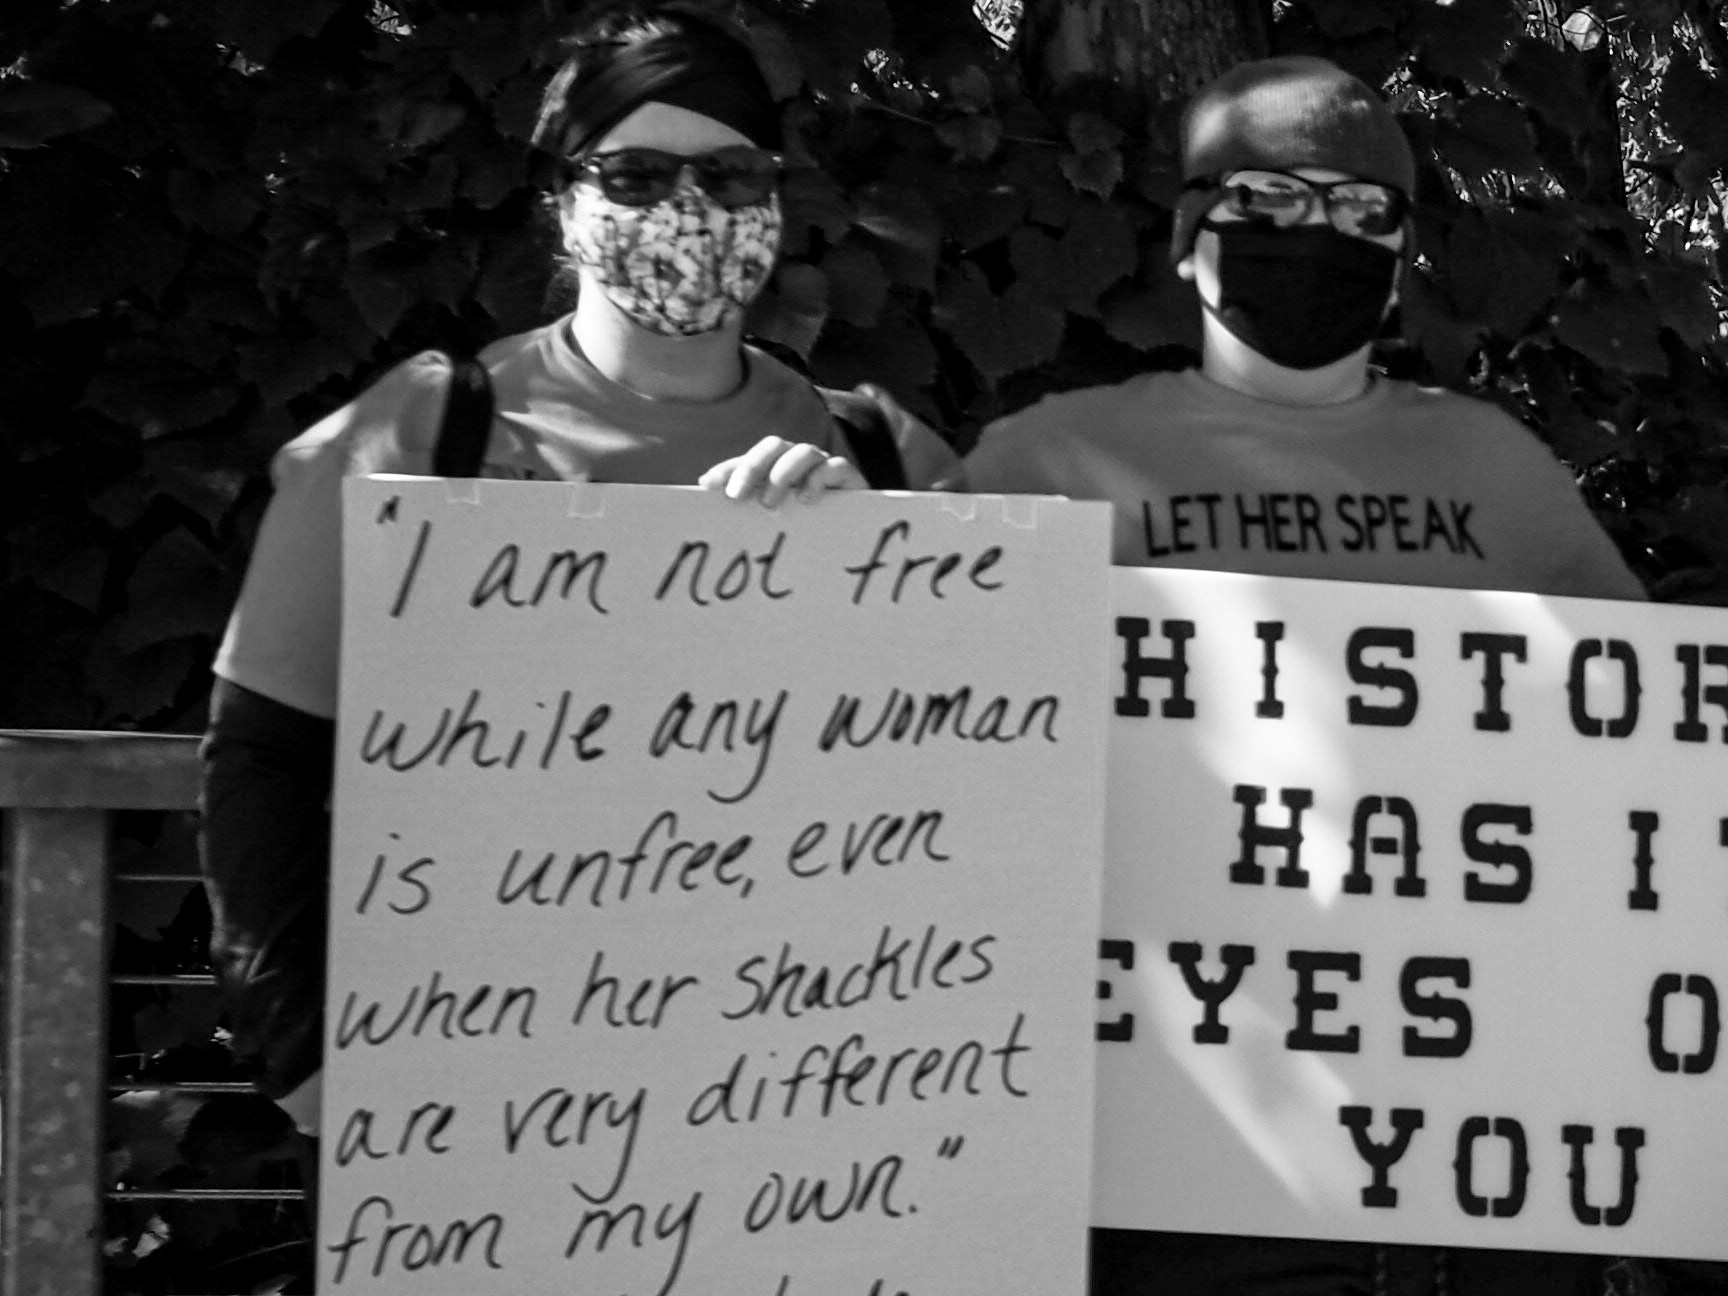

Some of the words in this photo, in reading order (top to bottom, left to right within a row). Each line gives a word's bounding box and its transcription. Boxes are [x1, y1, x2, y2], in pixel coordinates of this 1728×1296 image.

[470, 540, 608, 612] am
[655, 532, 793, 606] not
[846, 524, 1004, 604] free
[1142, 494, 1222, 558] LET
[1234, 493, 1328, 554] HER
[1335, 493, 1486, 561] SPEAK
[362, 690, 606, 771] while
[650, 689, 789, 802] any
[819, 688, 1059, 751] woman
[358, 833, 433, 914] is
[497, 812, 756, 907] unfree,
[789, 807, 950, 878] even
[1229, 784, 1535, 904] HAS
[336, 972, 537, 1049] when
[574, 952, 698, 1028] her
[336, 1100, 454, 1166] are
[506, 1087, 645, 1202] very
[688, 1014, 1031, 1128] different
[1339, 1106, 1646, 1226] YOU
[328, 1196, 503, 1284] from
